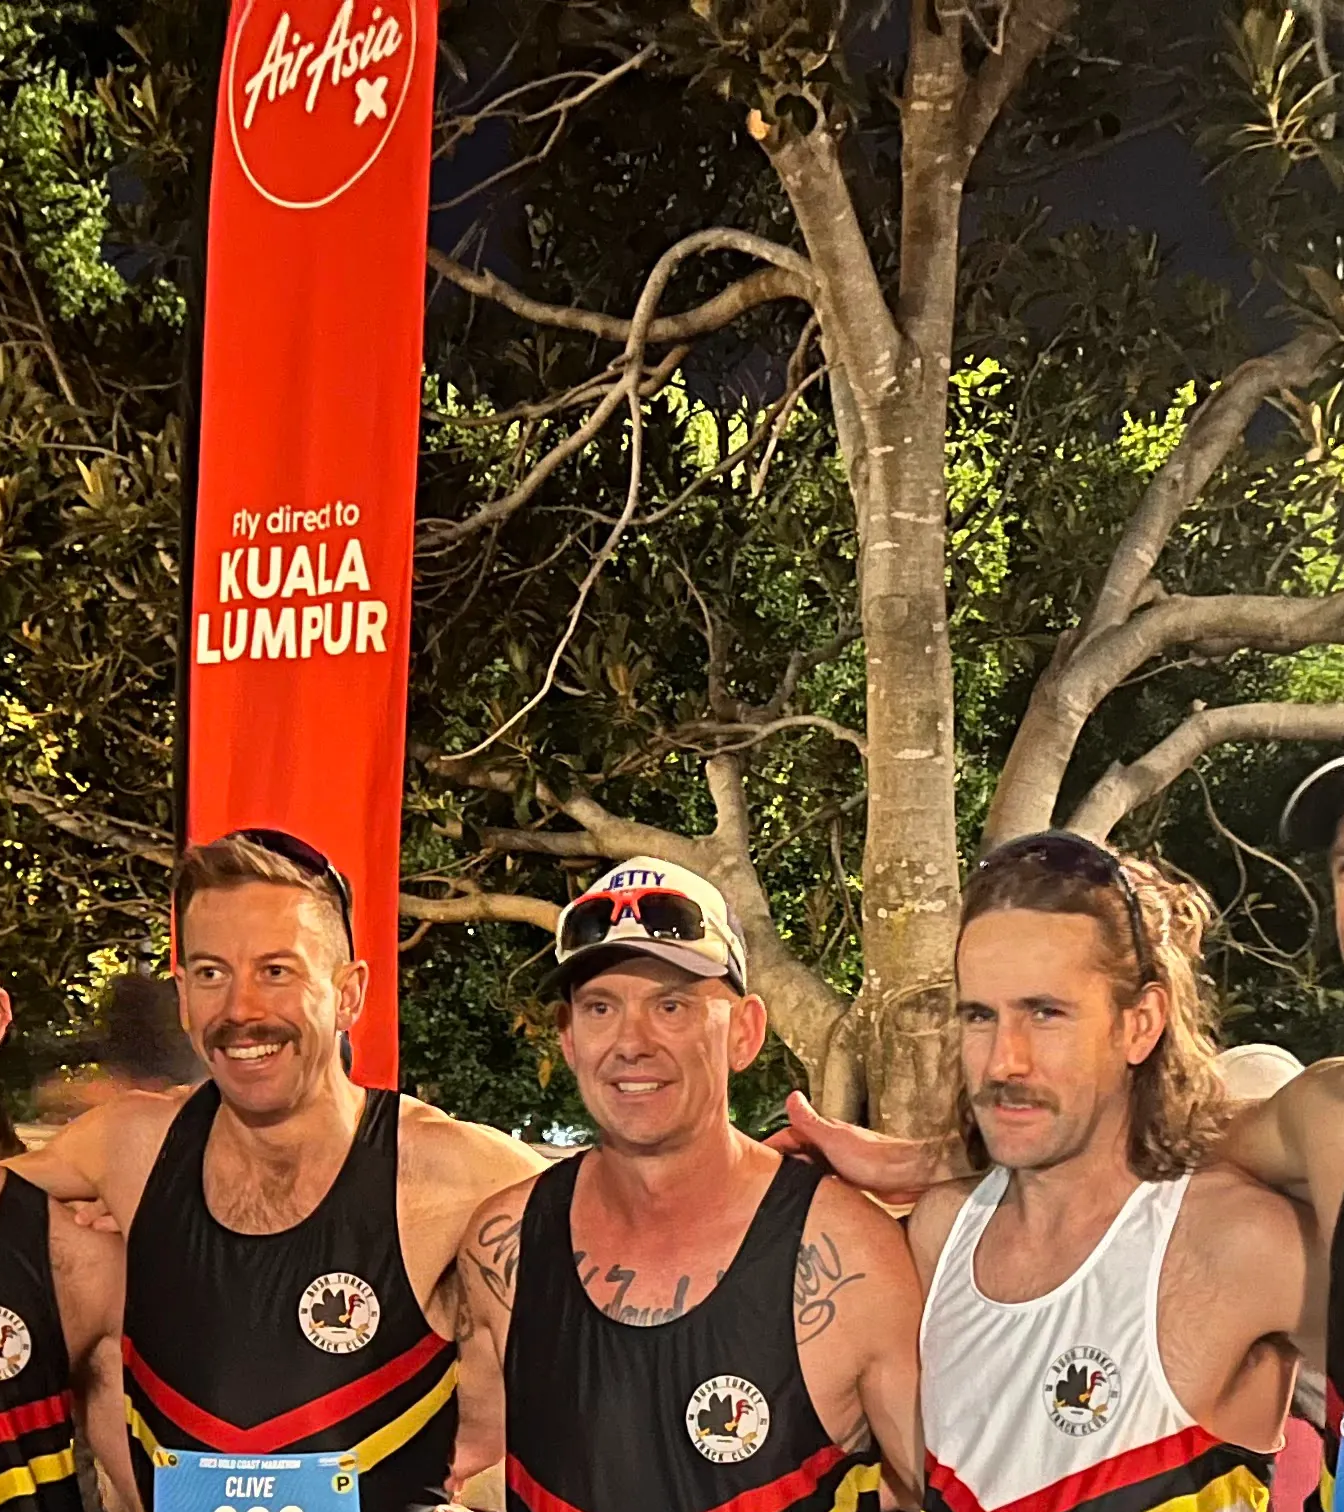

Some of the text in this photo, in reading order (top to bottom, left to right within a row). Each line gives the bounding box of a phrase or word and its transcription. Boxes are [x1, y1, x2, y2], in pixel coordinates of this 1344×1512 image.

[334, 500, 360, 528] to
[219, 538, 371, 603] KUALA
[196, 600, 389, 665] LUMPUR
[602, 869, 666, 892] JETTY
[336, 1273, 375, 1299] TURKEY
[307, 1328, 339, 1352] TRACK
[724, 1377, 764, 1405] TURKEY
[694, 1438, 725, 1462] TRACK
[225, 1475, 276, 1498] CLIVE
[336, 1475, 350, 1492] P
